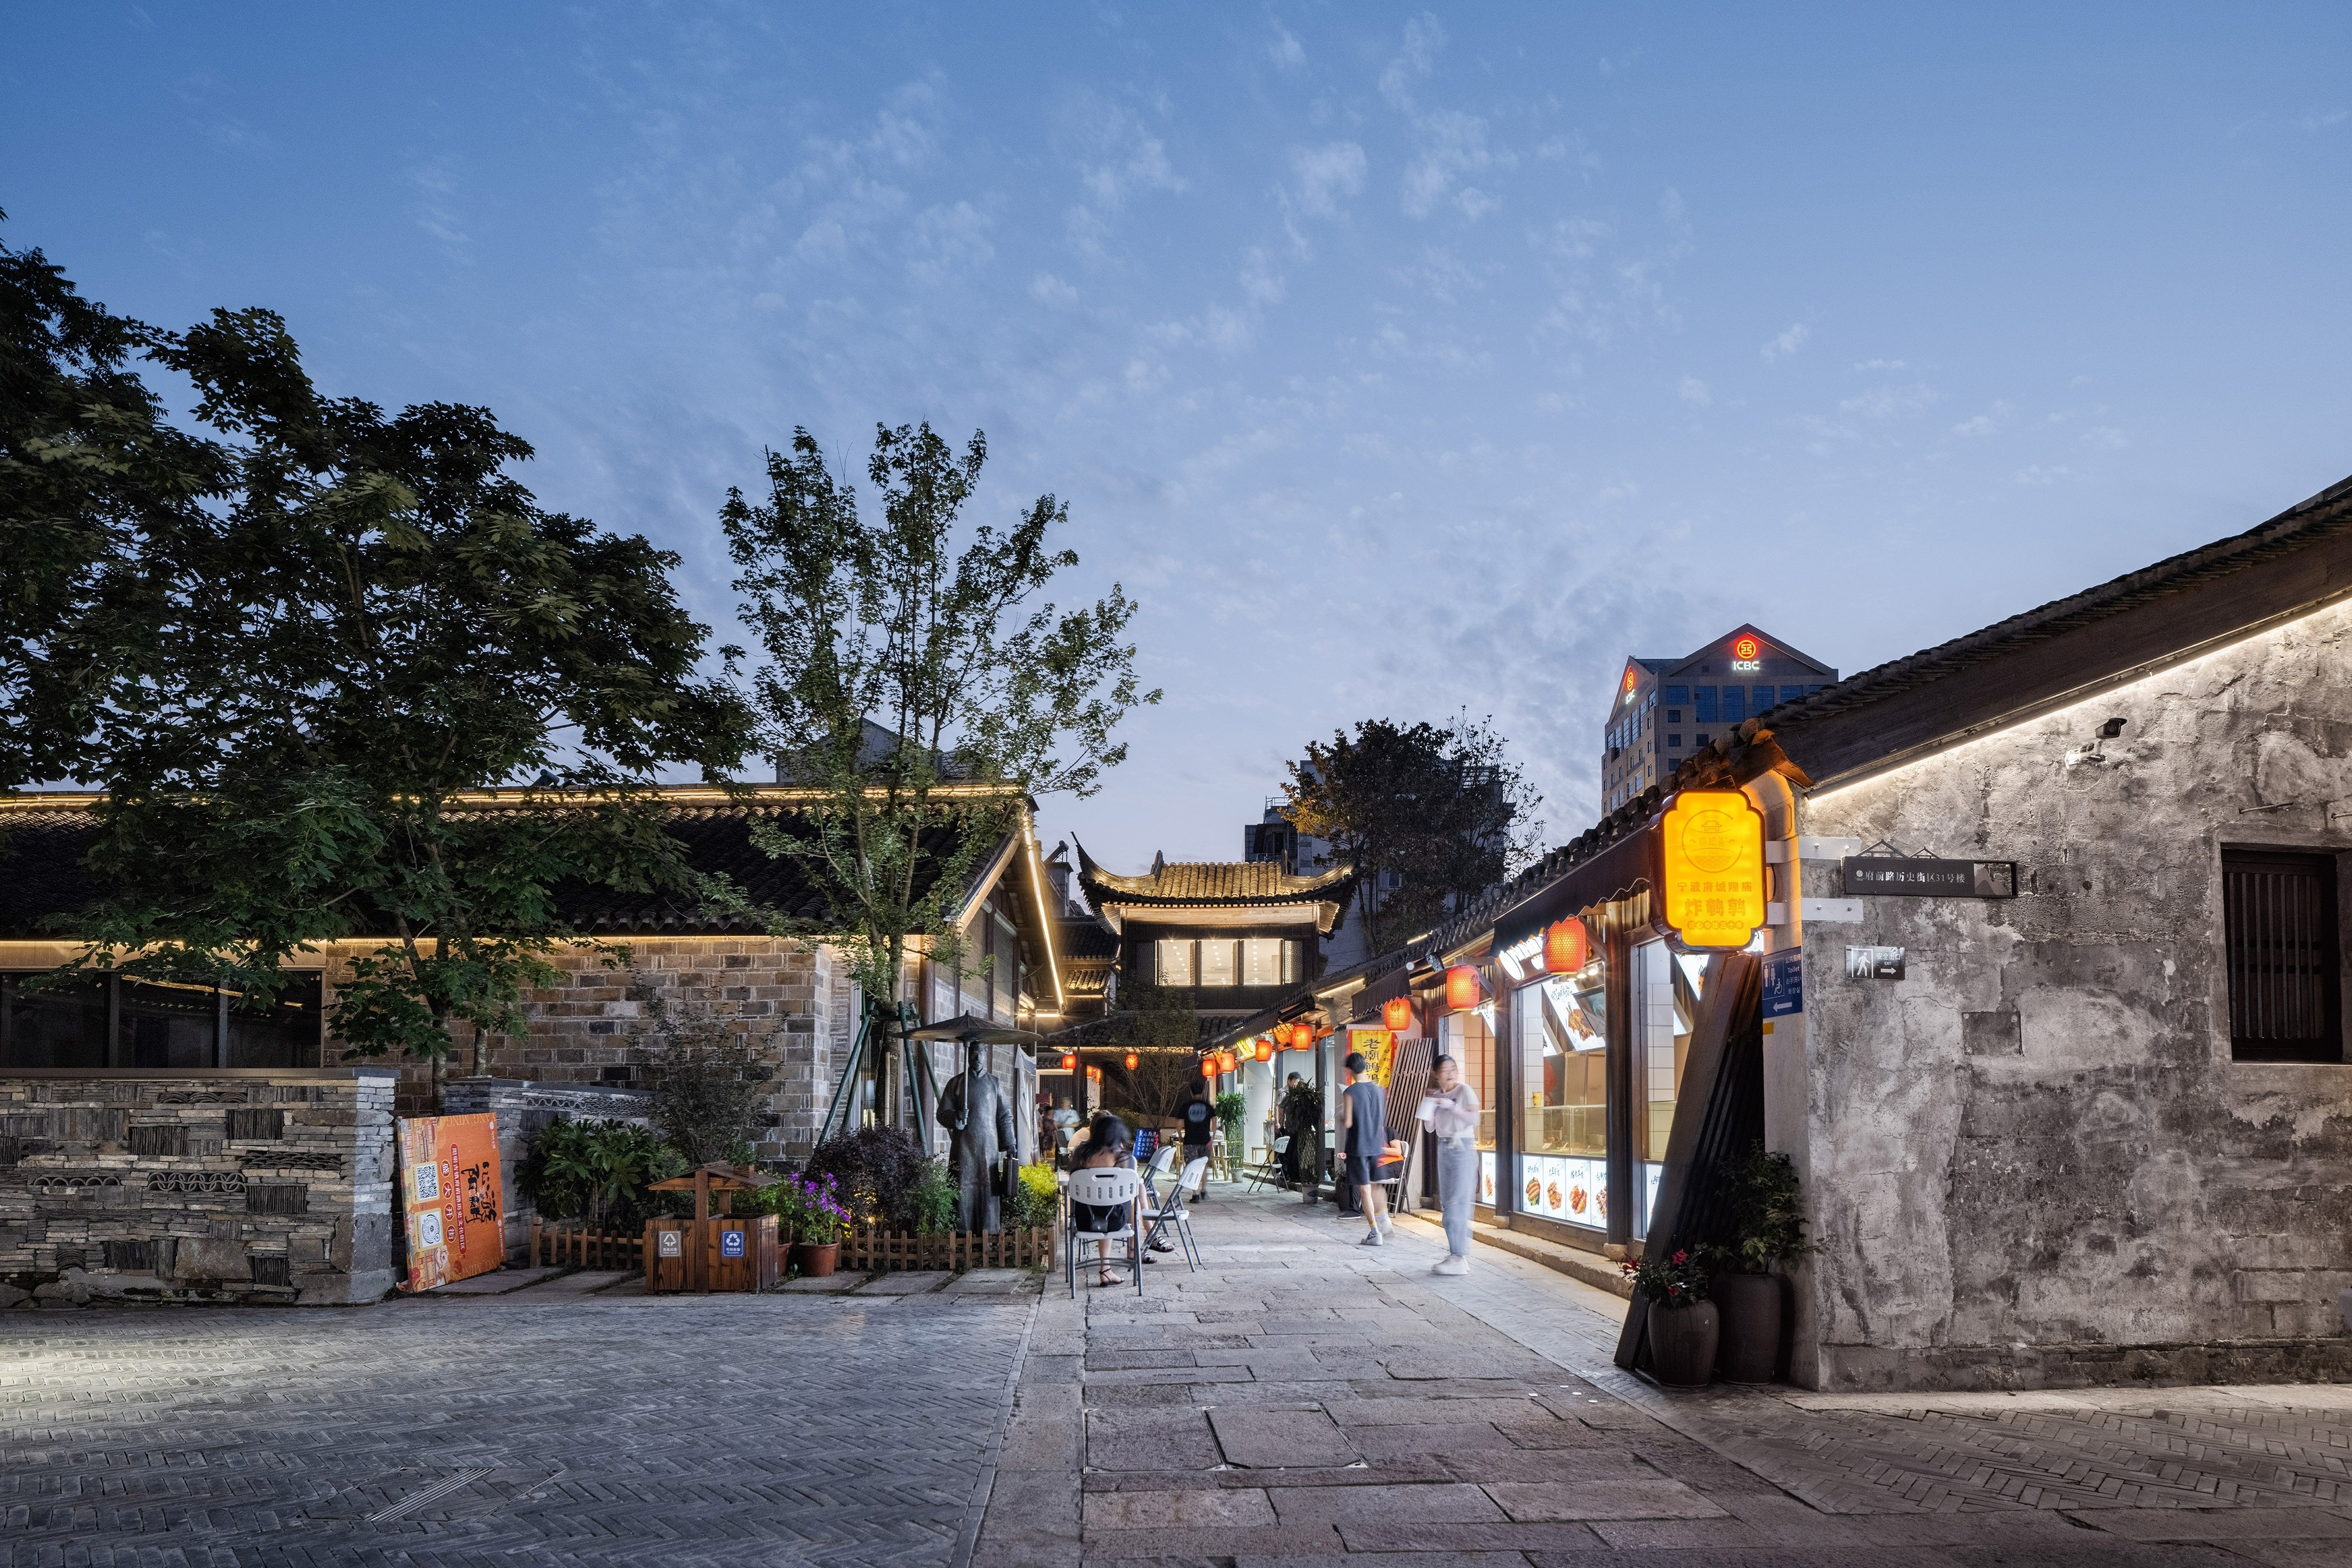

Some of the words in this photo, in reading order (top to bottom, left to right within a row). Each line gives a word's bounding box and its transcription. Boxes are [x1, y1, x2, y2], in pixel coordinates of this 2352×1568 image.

[1733, 660, 1760, 671] ICBC
[1865, 870, 1965, 883] 府前路历史街区31号楼
[1677, 881, 1752, 892] 宁波府城隍庙
[1685, 898, 1746, 917] 炸鹌鹑
[1688, 921, 1744, 930] 匠心专注三十年
[1785, 954, 1801, 964] 公共厕所
[1786, 976, 1802, 985] お手洗い
